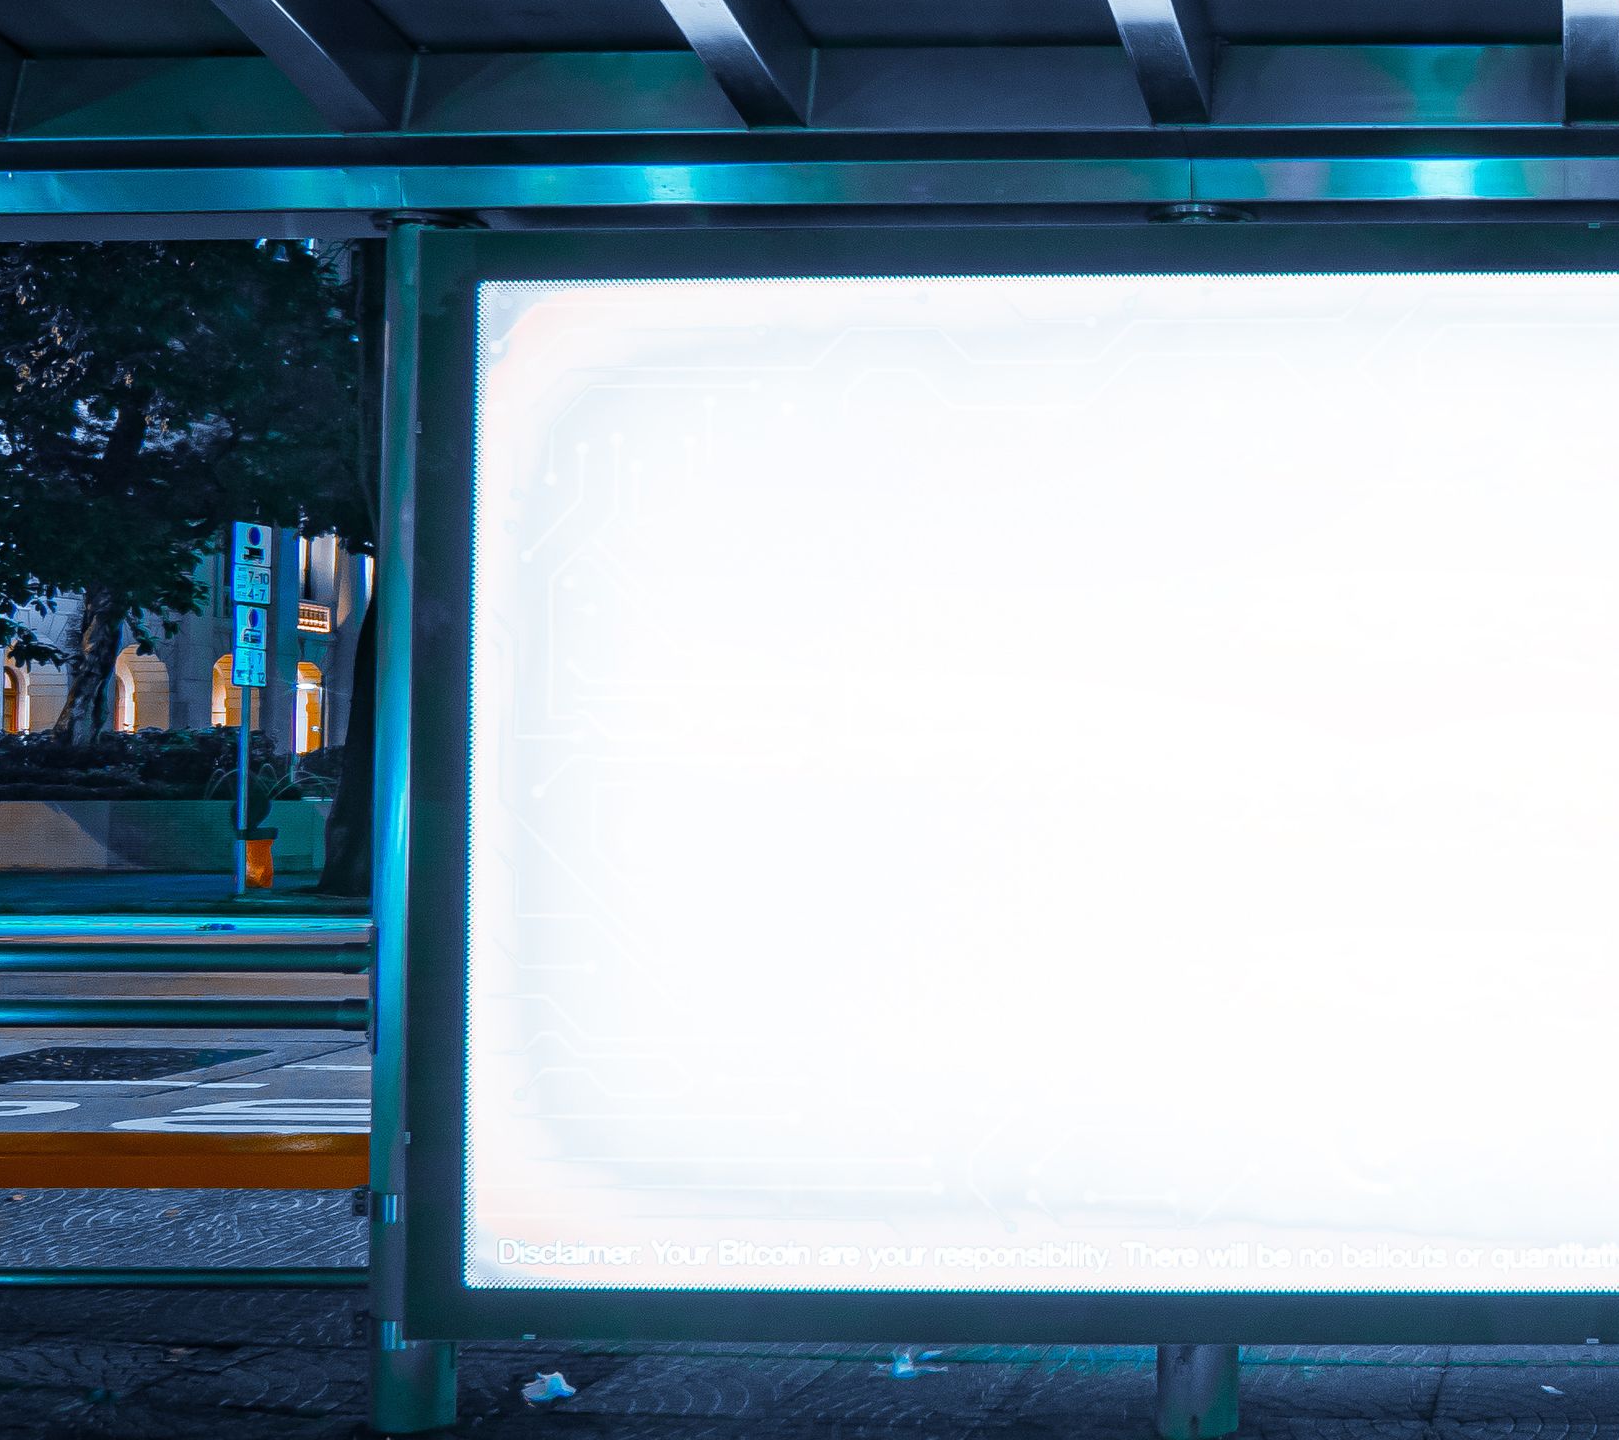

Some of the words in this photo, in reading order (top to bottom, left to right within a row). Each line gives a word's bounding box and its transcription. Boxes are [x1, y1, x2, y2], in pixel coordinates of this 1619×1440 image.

[248, 570, 270, 585] 7-10
[247, 588, 266, 602] 4-7
[496, 1238, 642, 1267] Disclaimer:
[651, 1239, 711, 1267] Your
[718, 1239, 811, 1268] Bitcoin
[818, 1245, 862, 1268] are
[867, 1245, 926, 1273] your
[1119, 1241, 1200, 1270] There
[1207, 1241, 1249, 1270] will
[1256, 1241, 1292, 1270] be
[1299, 1248, 1334, 1270] no
[1341, 1241, 1447, 1270] bailouts
[1455, 1248, 1485, 1270] or
